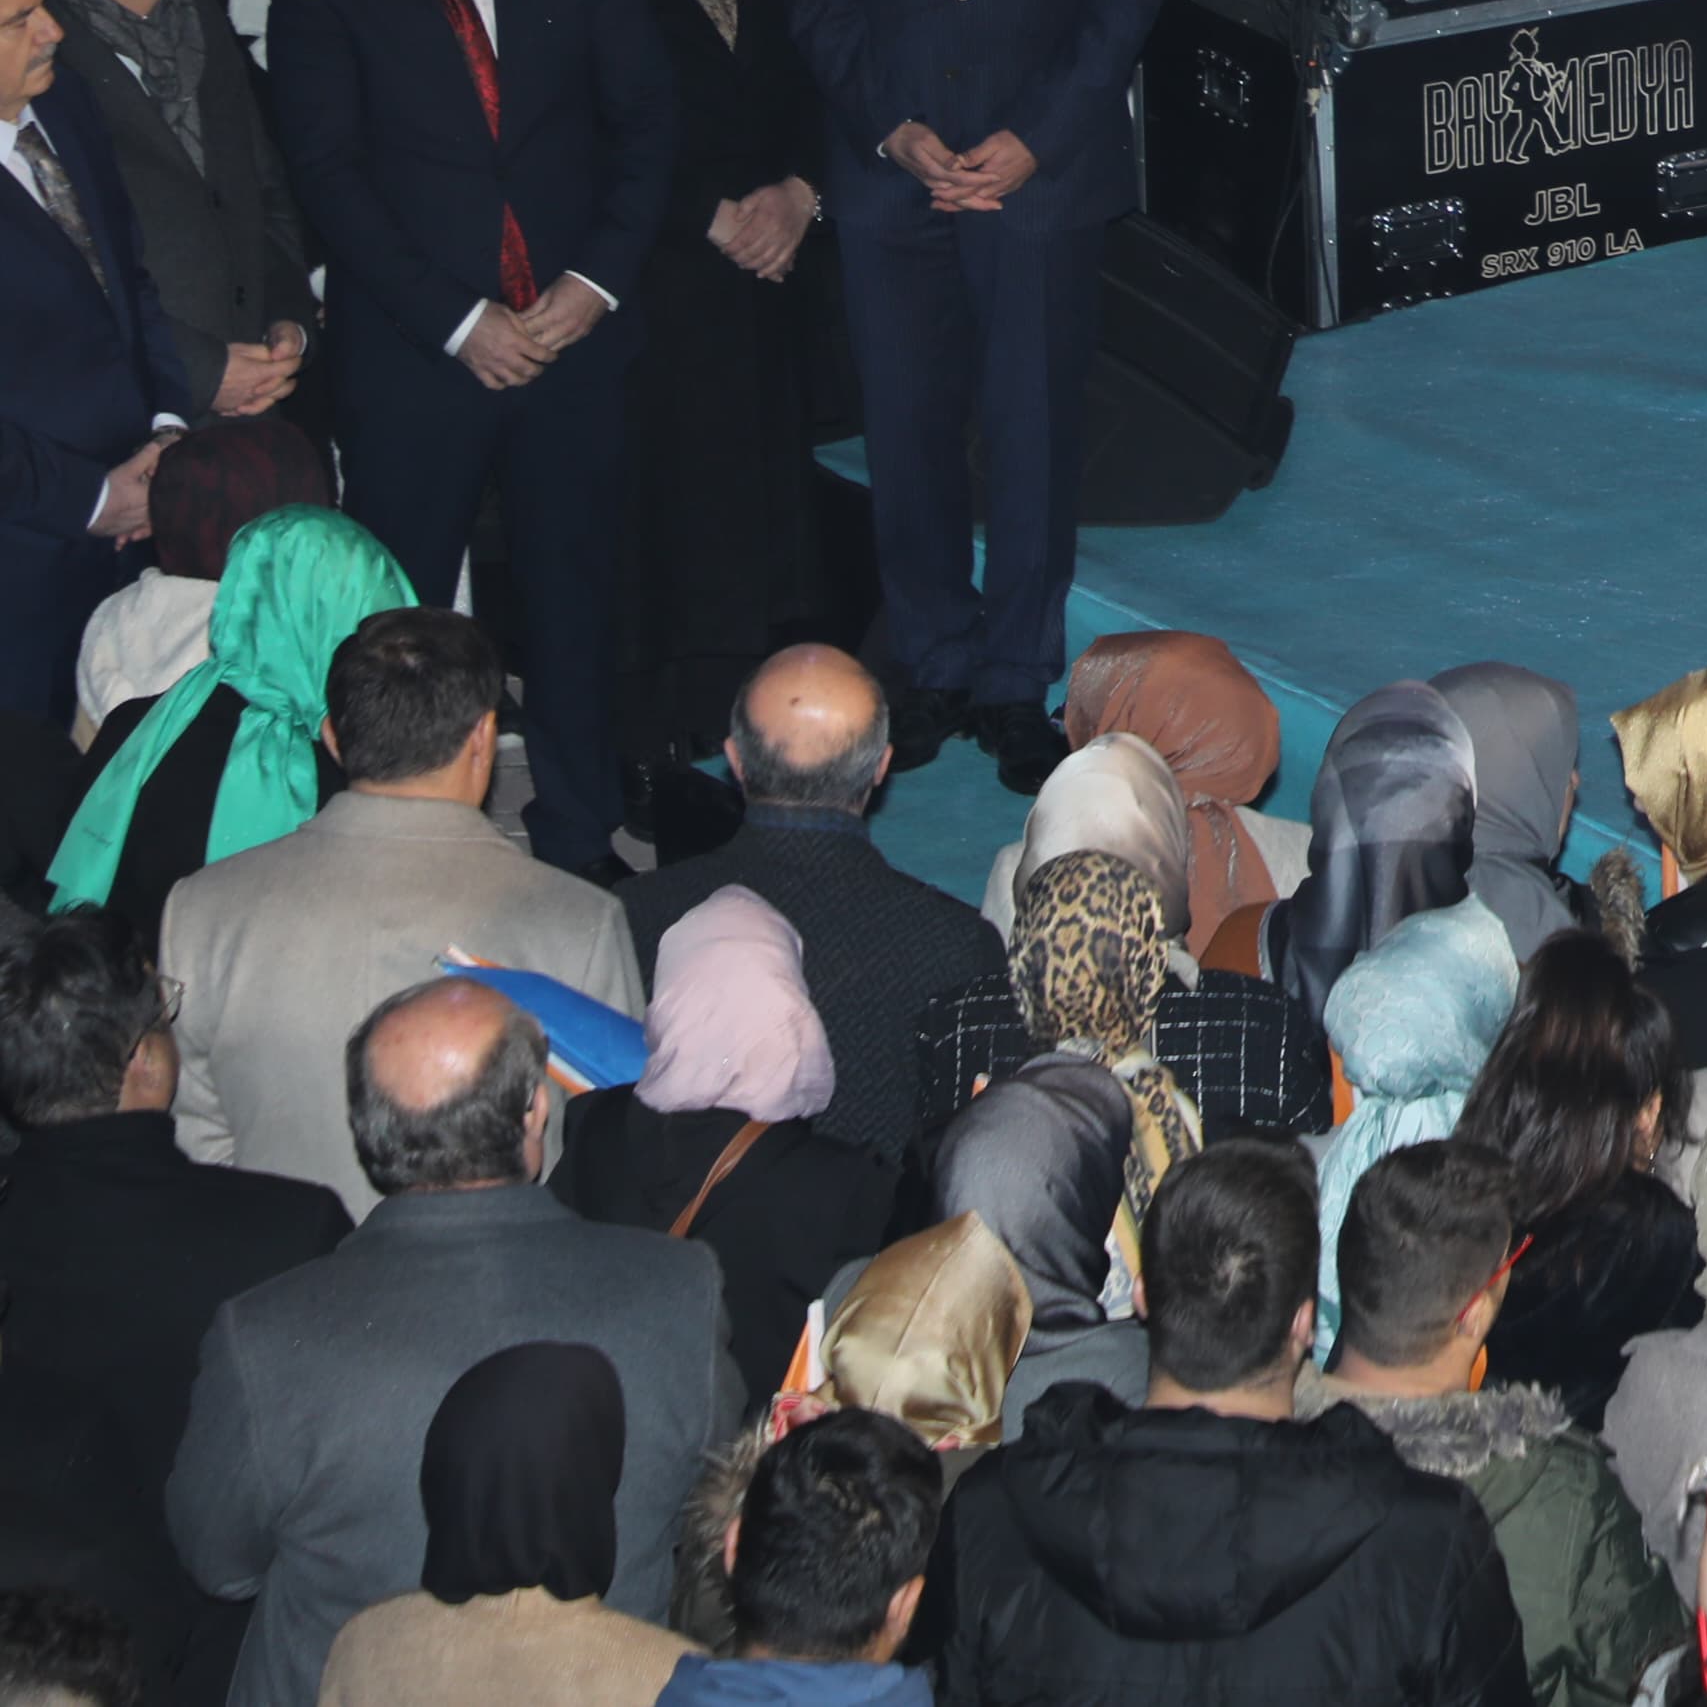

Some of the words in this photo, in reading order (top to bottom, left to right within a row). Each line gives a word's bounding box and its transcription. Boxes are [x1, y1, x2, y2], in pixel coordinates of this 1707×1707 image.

[1548, 39, 1694, 151] MEDYA
[1524, 183, 1601, 226] JBL
[1481, 247, 1539, 279] SRX
[1548, 236, 1596, 267] 910
[1605, 228, 1644, 257] LA
